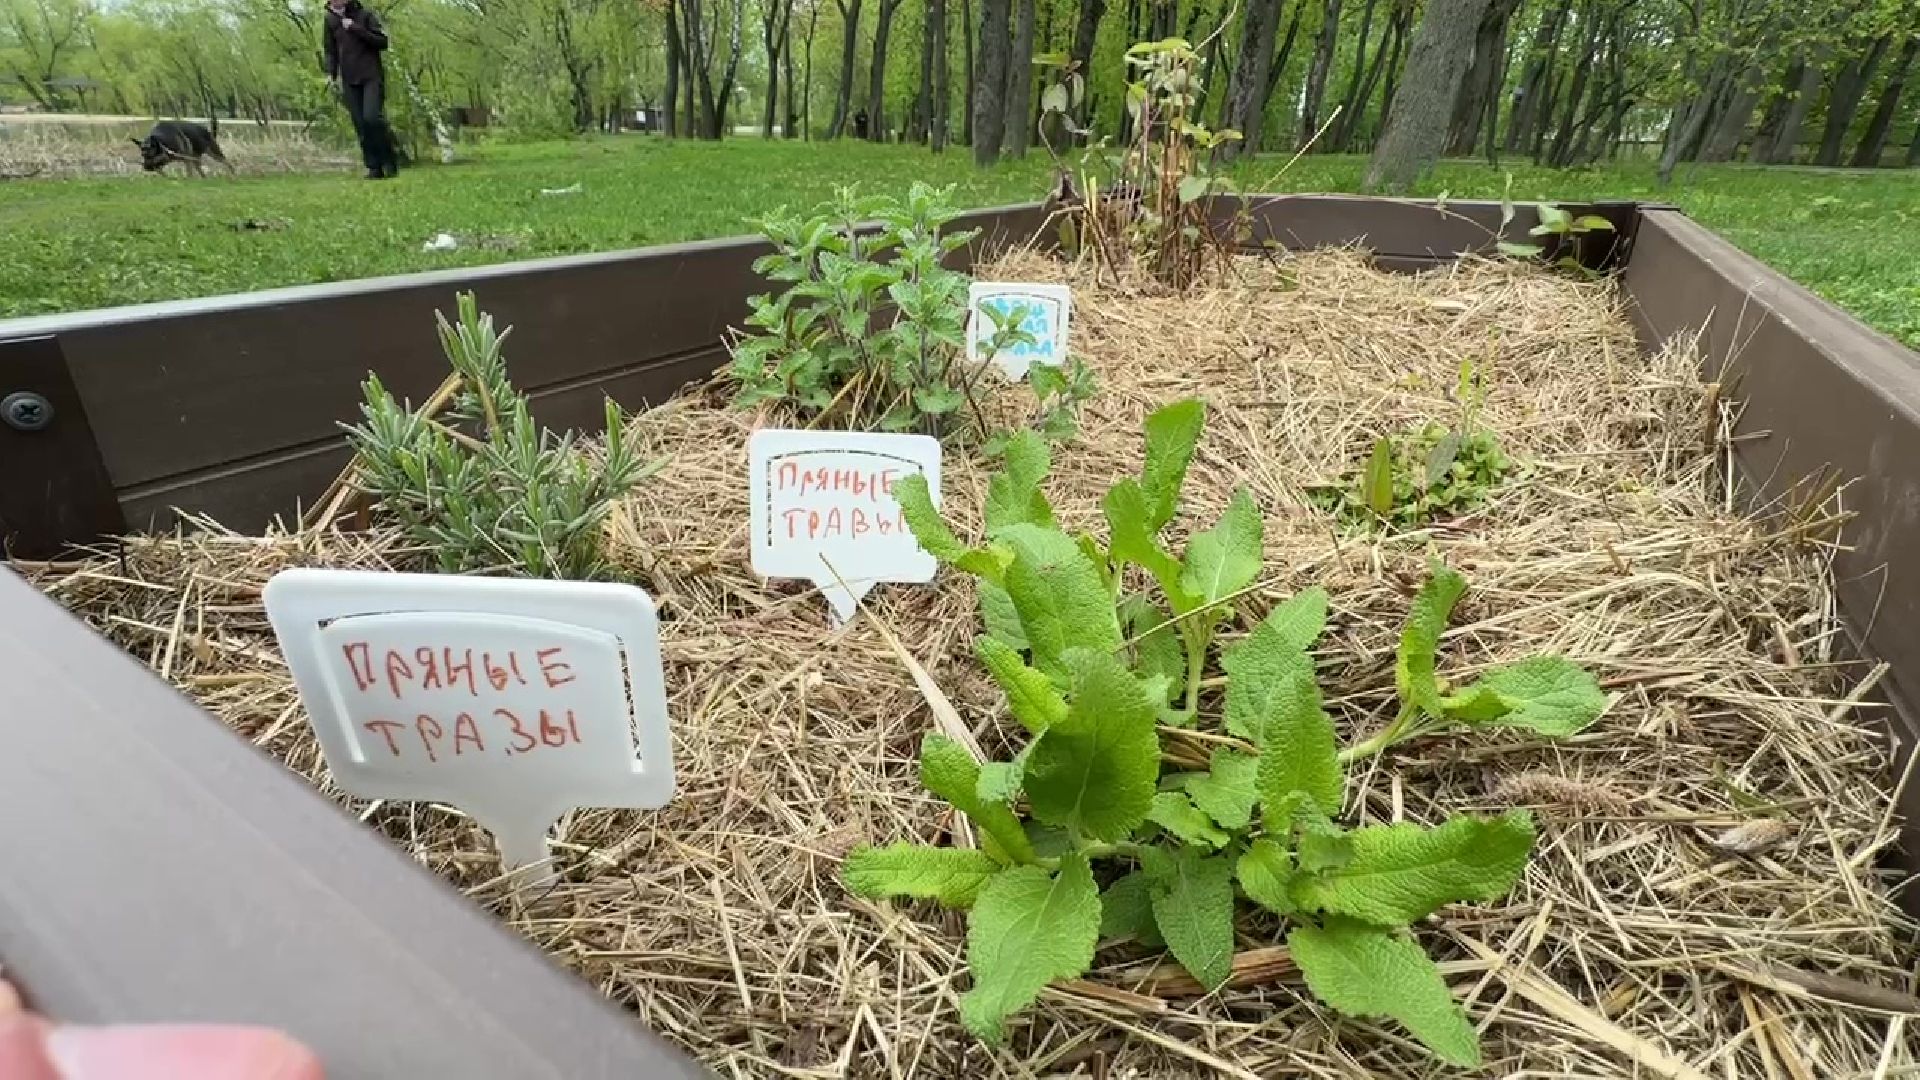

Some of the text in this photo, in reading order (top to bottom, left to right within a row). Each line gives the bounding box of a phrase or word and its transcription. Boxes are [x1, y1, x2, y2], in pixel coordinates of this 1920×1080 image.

[777, 461, 900, 502] ПРЯНЫЕ
[781, 506, 906, 540] ТРАВЫ
[343, 642, 577, 698] ПРЯНЫЕ
